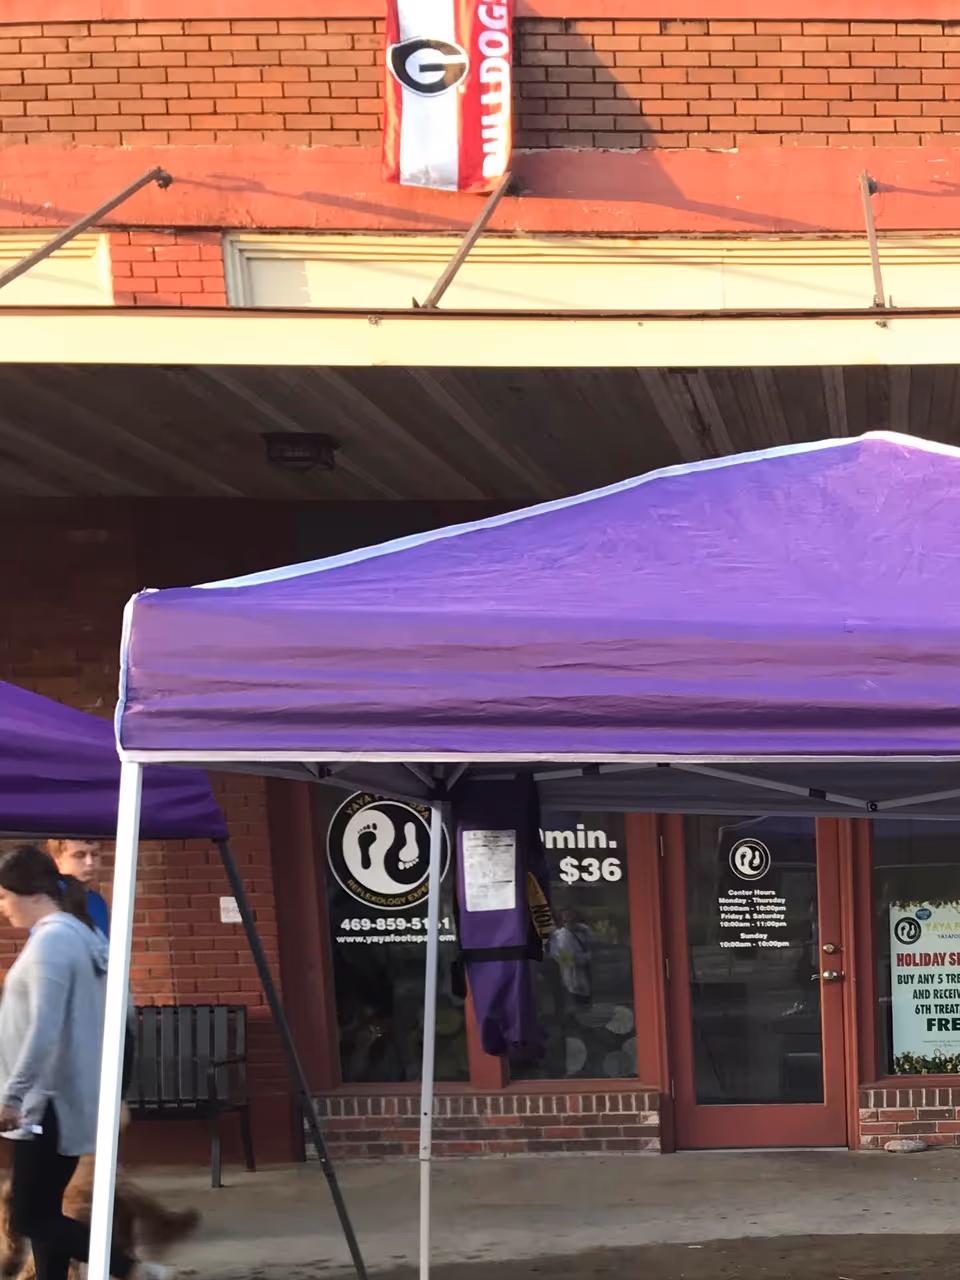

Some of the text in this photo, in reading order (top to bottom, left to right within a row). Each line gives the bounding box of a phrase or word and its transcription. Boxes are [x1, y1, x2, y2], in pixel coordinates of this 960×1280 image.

[478, 0, 510, 177] BULLDOG
[539, 824, 617, 848] min.
[559, 856, 622, 885] $36
[347, 879, 407, 905] REFLEXOLOGY
[341, 917, 450, 931] 469-859-511
[925, 922, 952, 930] YAYA
[336, 934, 457, 944] www.yayafootspaom
[896, 952, 947, 967] HOLIDAY
[897, 974, 914, 984] BUY
[918, 974, 934, 984] ANY
[938, 974, 944, 984] 5
[912, 989, 930, 1000] AND
[914, 1004, 932, 1015] 6TH
